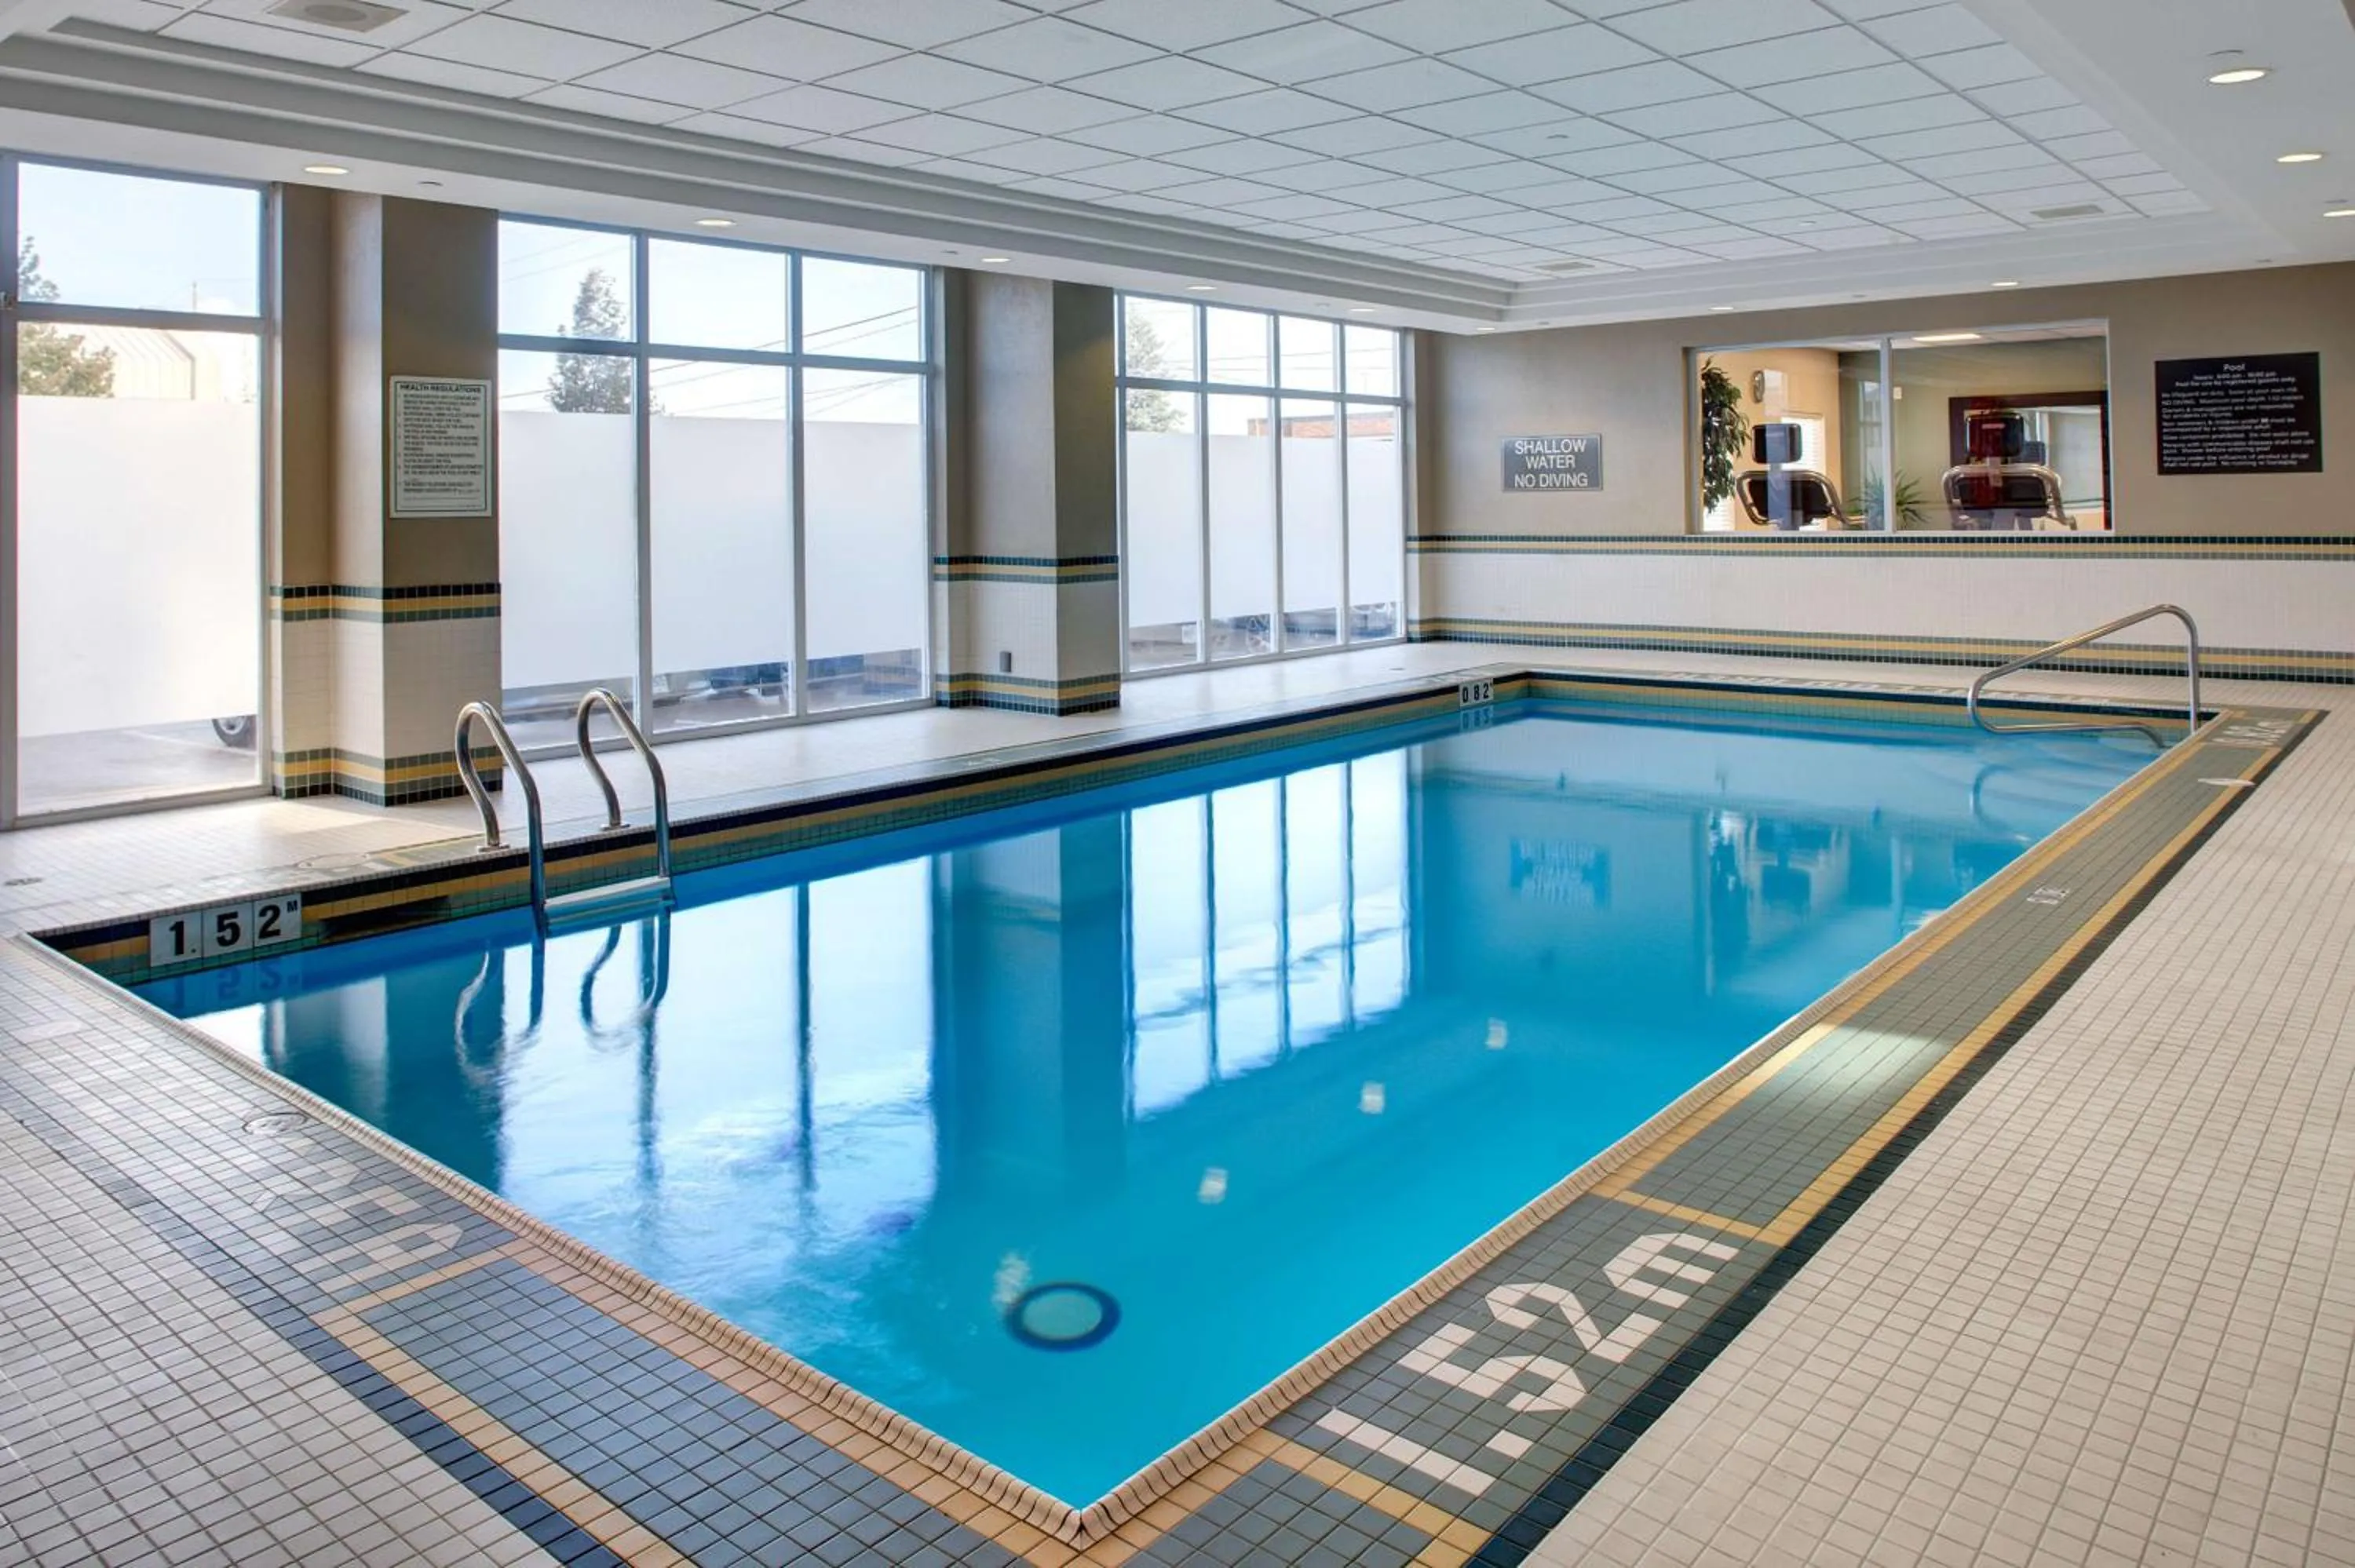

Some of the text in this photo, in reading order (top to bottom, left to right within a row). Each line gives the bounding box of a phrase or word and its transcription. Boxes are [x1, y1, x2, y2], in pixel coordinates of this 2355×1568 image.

[2223, 363, 2246, 372] Pool
[1514, 439, 1586, 455] SHALLOW
[1525, 454, 1575, 470] WATER
[1514, 472, 1588, 488] NO DIVING
